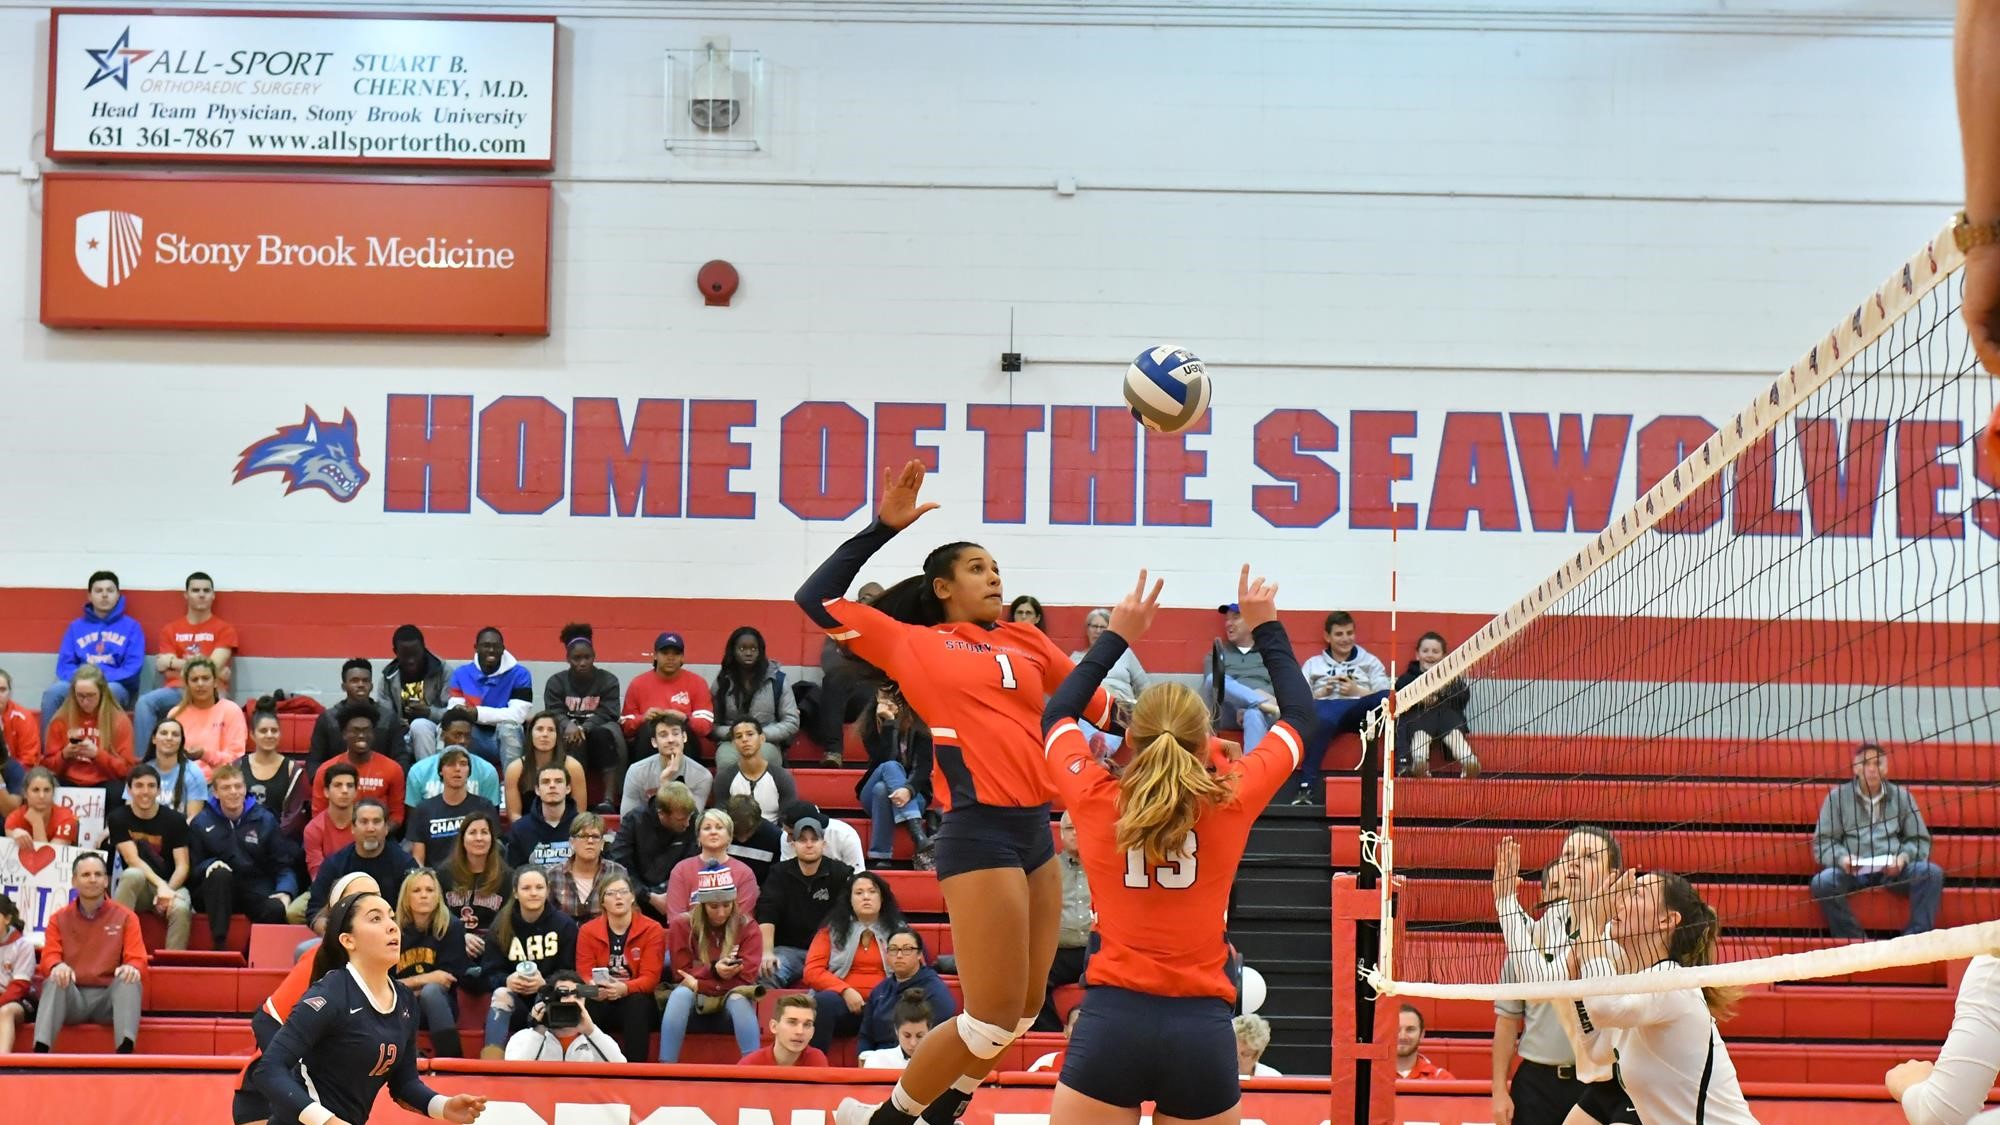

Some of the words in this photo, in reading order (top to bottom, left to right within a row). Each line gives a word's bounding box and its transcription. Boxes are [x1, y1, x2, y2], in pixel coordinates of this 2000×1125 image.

[148, 49, 334, 76] ALL-SPORT
[353, 53, 441, 73] STUART
[448, 56, 468, 73] B.
[140, 78, 248, 95] ORTHOPAEDIC
[252, 79, 323, 96] SURGERY
[353, 77, 470, 100] CHERNEY,
[480, 80, 528, 98] M.D.
[91, 101, 139, 119] Head
[150, 102, 196, 119] Team
[207, 103, 298, 124] Physician,
[305, 104, 357, 126] Stony
[367, 106, 421, 123] Brook
[433, 107, 528, 129] University
[88, 126, 123, 147] 631
[136, 127, 236, 149] 361-7867
[248, 130, 527, 157] www.allsportortho.com
[155, 233, 251, 272] Stony
[256, 234, 357, 268] Brook
[365, 236, 515, 270] Medicine
[383, 393, 757, 520] HOME
[779, 401, 947, 520] OF
[966, 403, 1213, 528] THE
[1251, 408, 2000, 540] SEAWOLVE
[994, 653, 1018, 690] 1
[56, 824, 72, 836] 12
[1124, 828, 1199, 890] 13
[508, 931, 558, 962] AHS
[368, 1042, 398, 1077] 12
